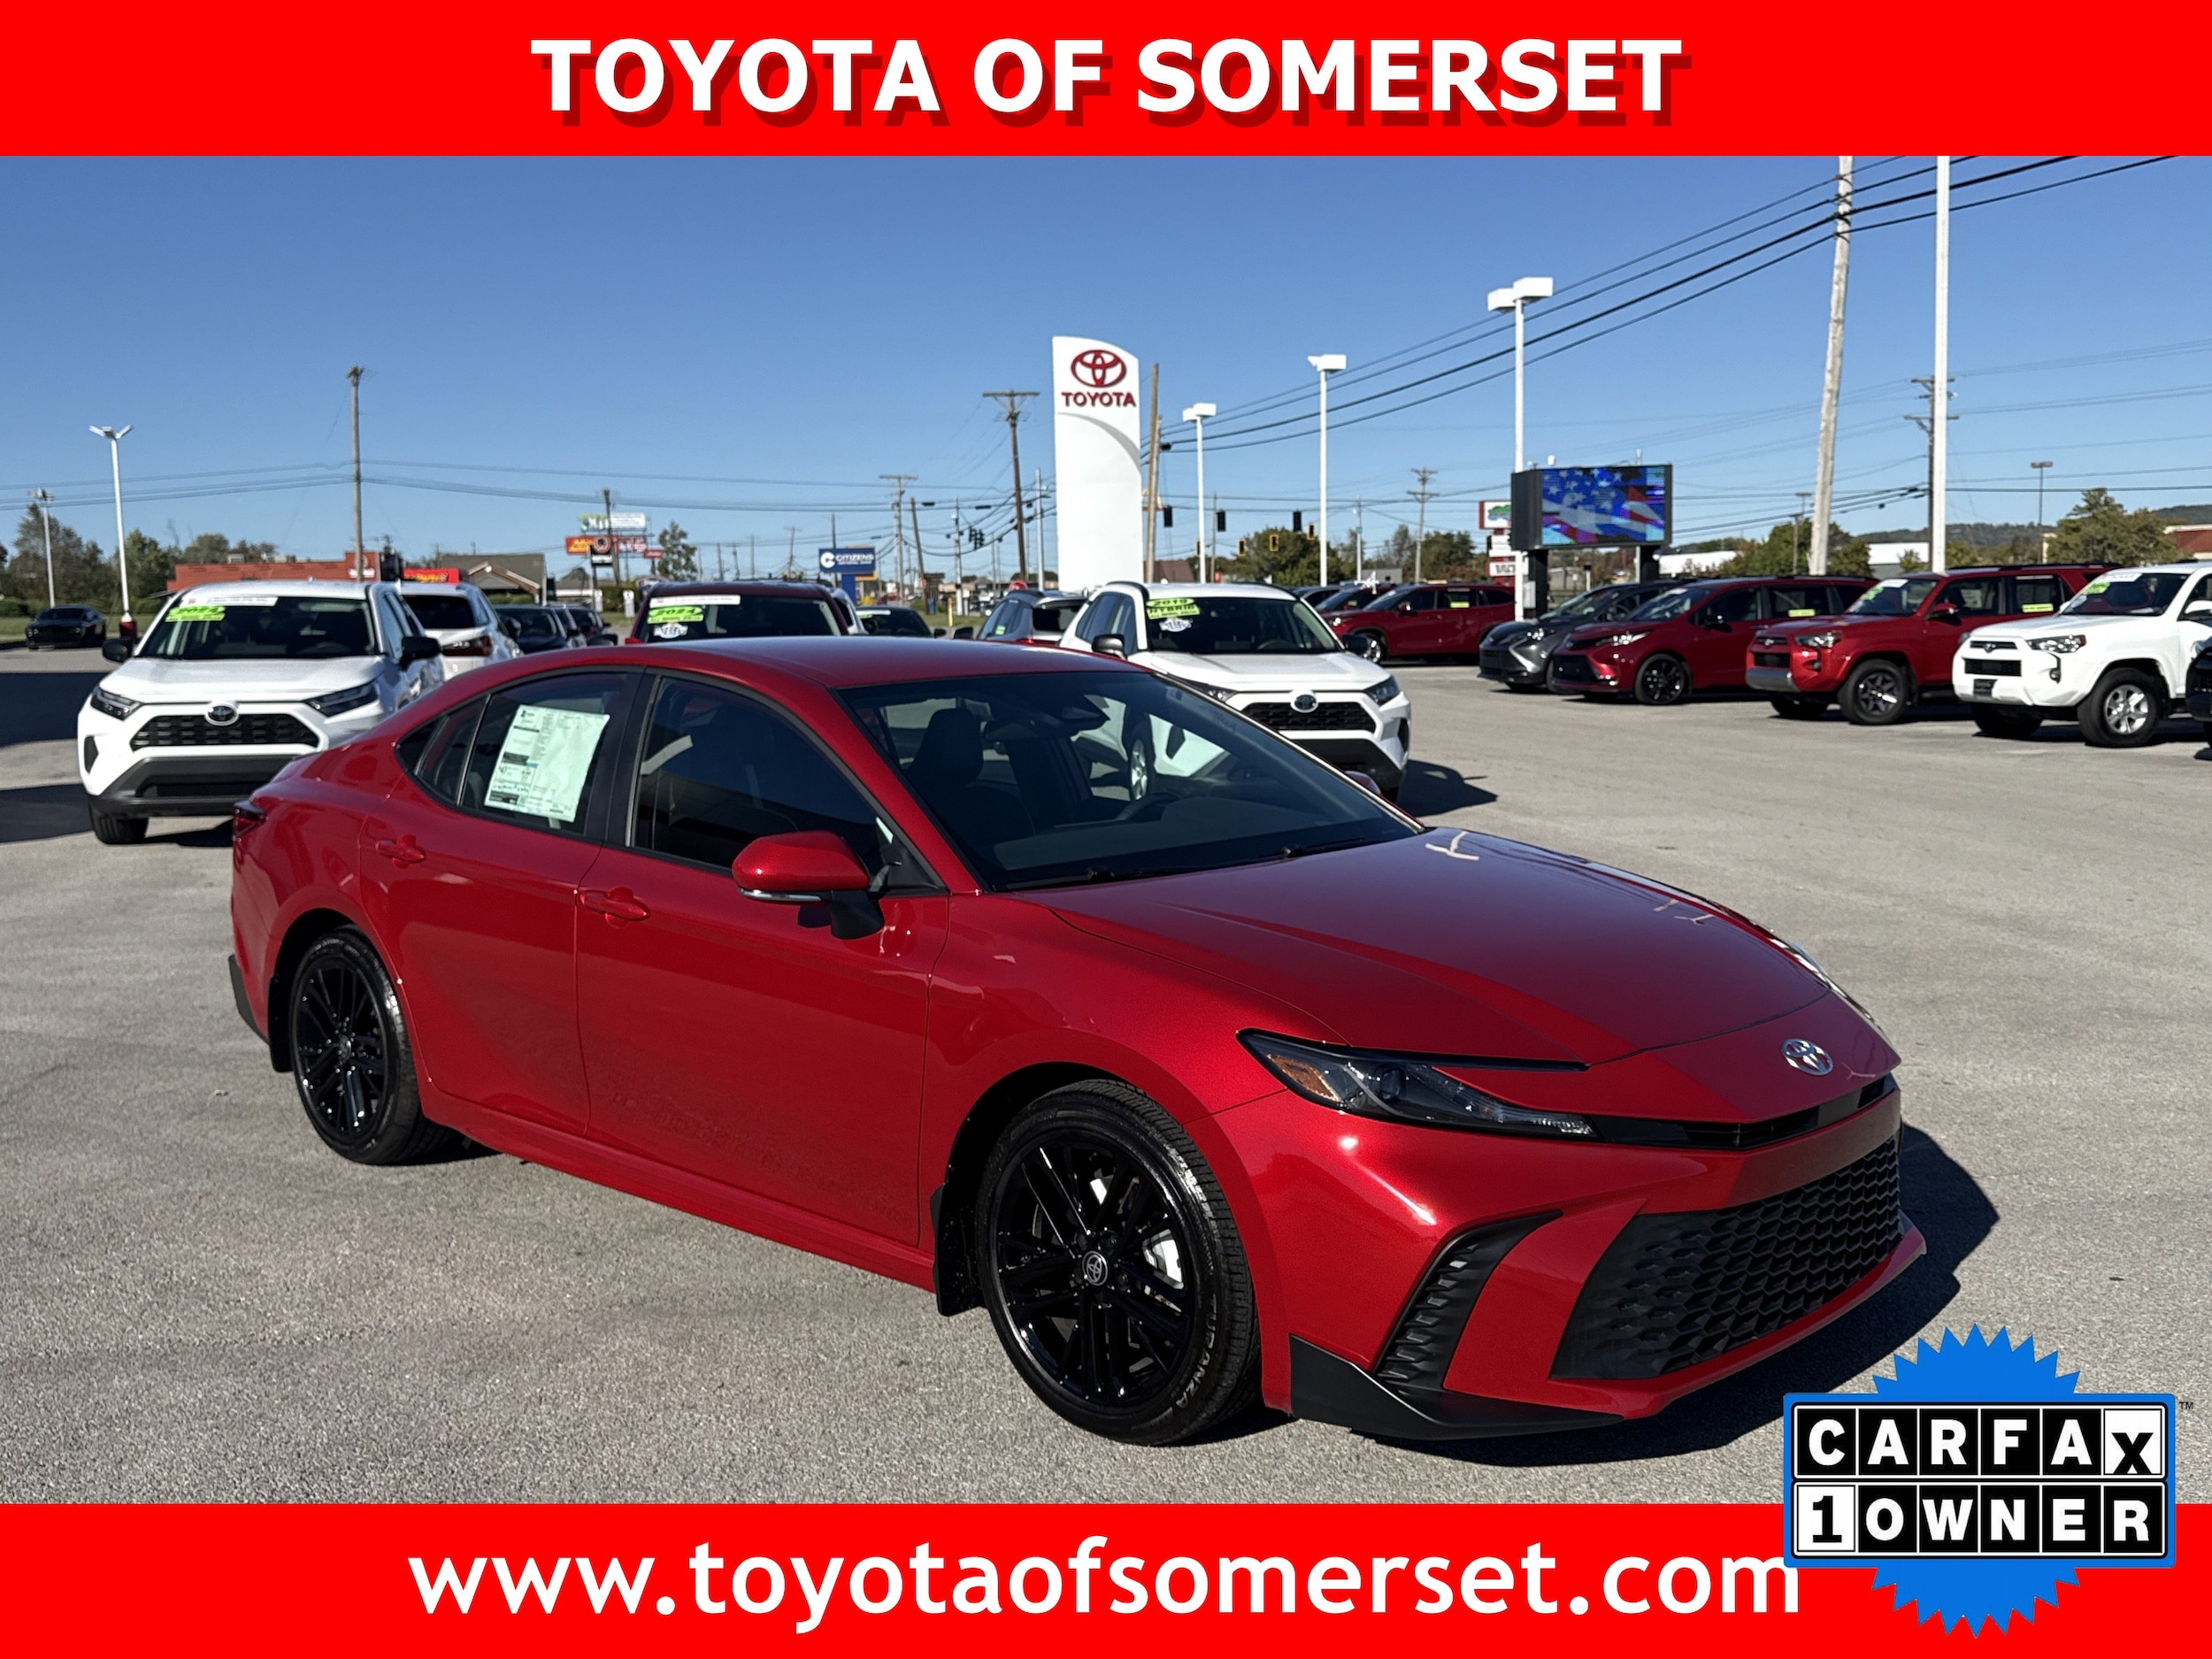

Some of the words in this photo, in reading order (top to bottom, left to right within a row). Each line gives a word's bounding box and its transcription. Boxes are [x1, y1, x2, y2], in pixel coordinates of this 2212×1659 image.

[1061, 391, 1137, 407] TOYOTA
[835, 553, 874, 562] CITIZENS
[654, 608, 695, 617] 2024
[1176, 1293, 1217, 1409] TURANZA
